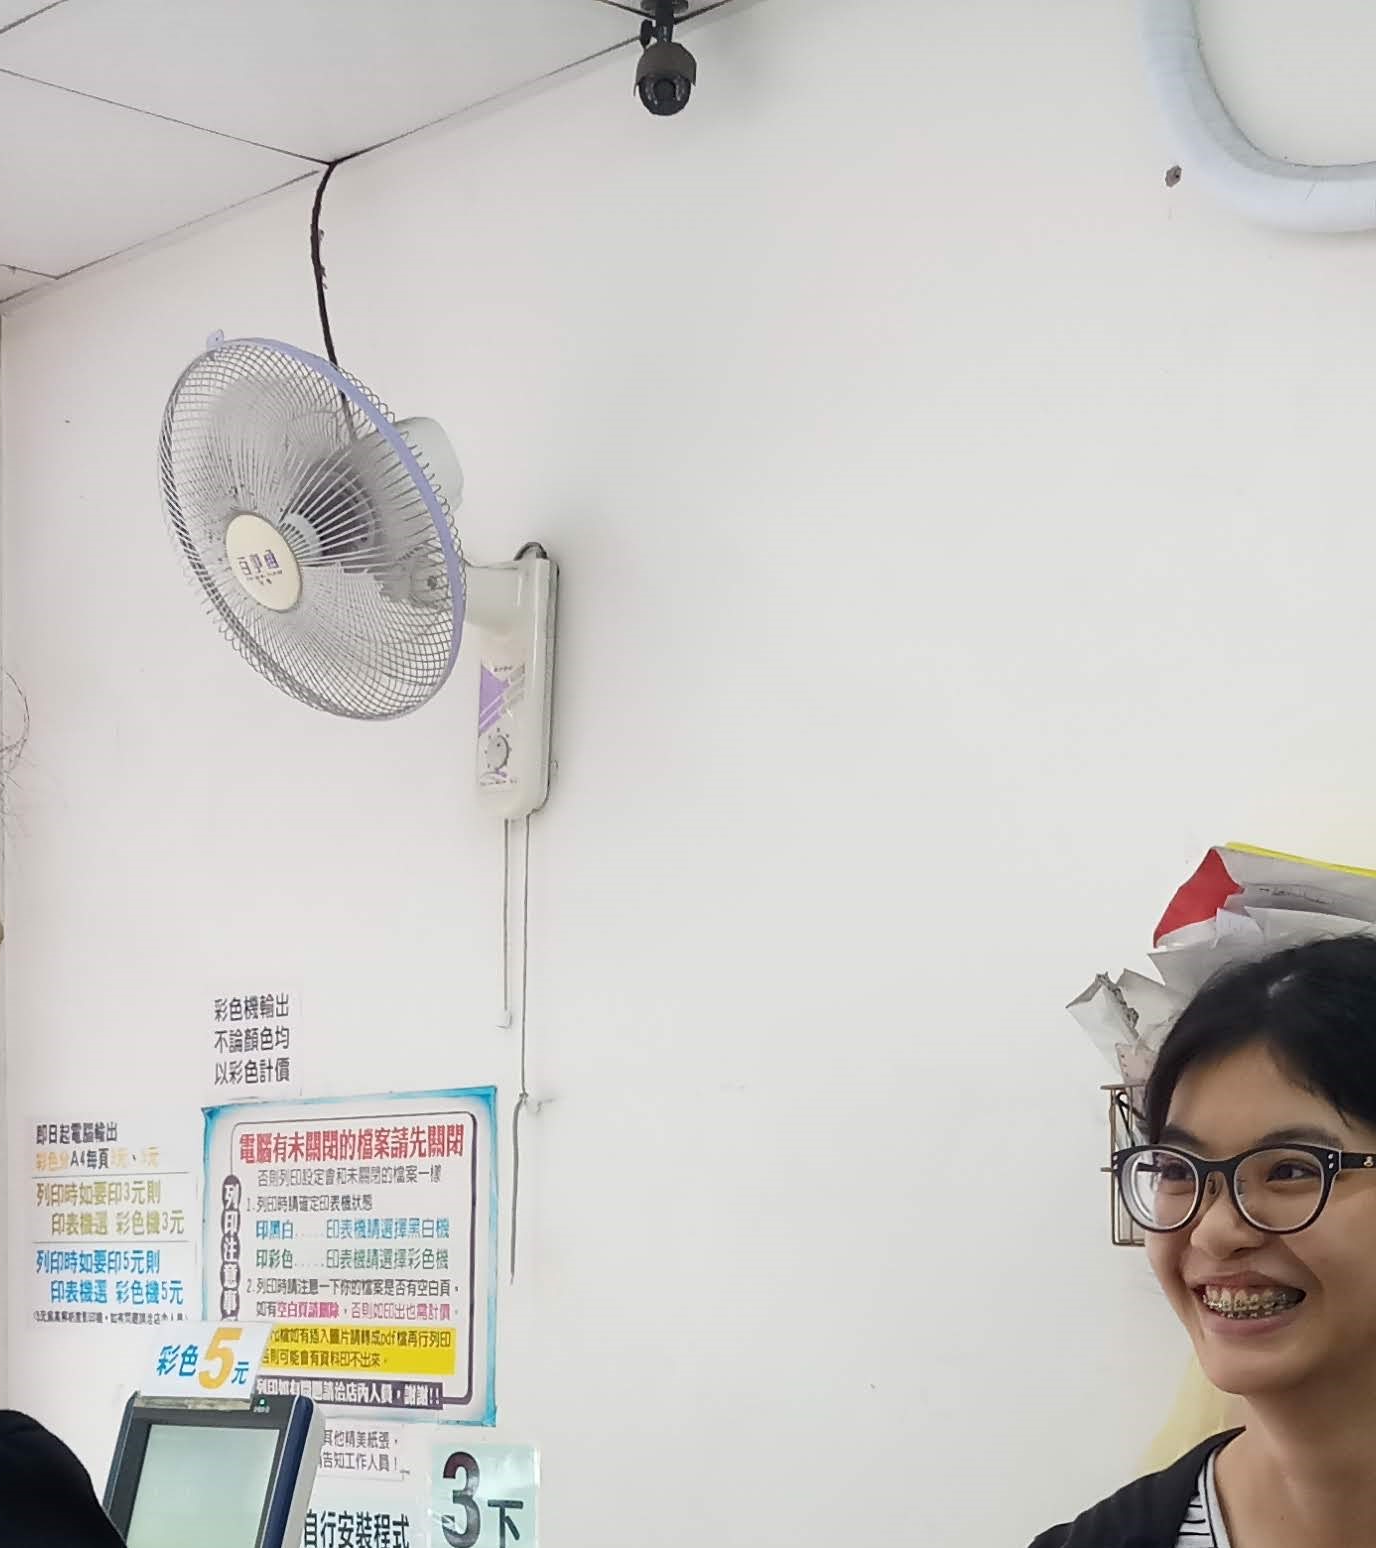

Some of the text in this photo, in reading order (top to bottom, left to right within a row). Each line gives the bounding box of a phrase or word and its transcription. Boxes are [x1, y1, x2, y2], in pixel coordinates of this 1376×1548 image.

[214, 993, 290, 1022] 彩色機輸出
[214, 1025, 291, 1053] 不論顏色均
[214, 1057, 291, 1085] 以彩色計價
[35, 1121, 119, 1146] 即日起電腦輸出
[239, 1123, 466, 1165] 電腦有未關閉的檔案請先關閉
[36, 1180, 162, 1207] 列印時如要印3元則
[35, 1249, 161, 1276] 列印時如要印5元則
[320, 1450, 398, 1472] 告知工作人員！
